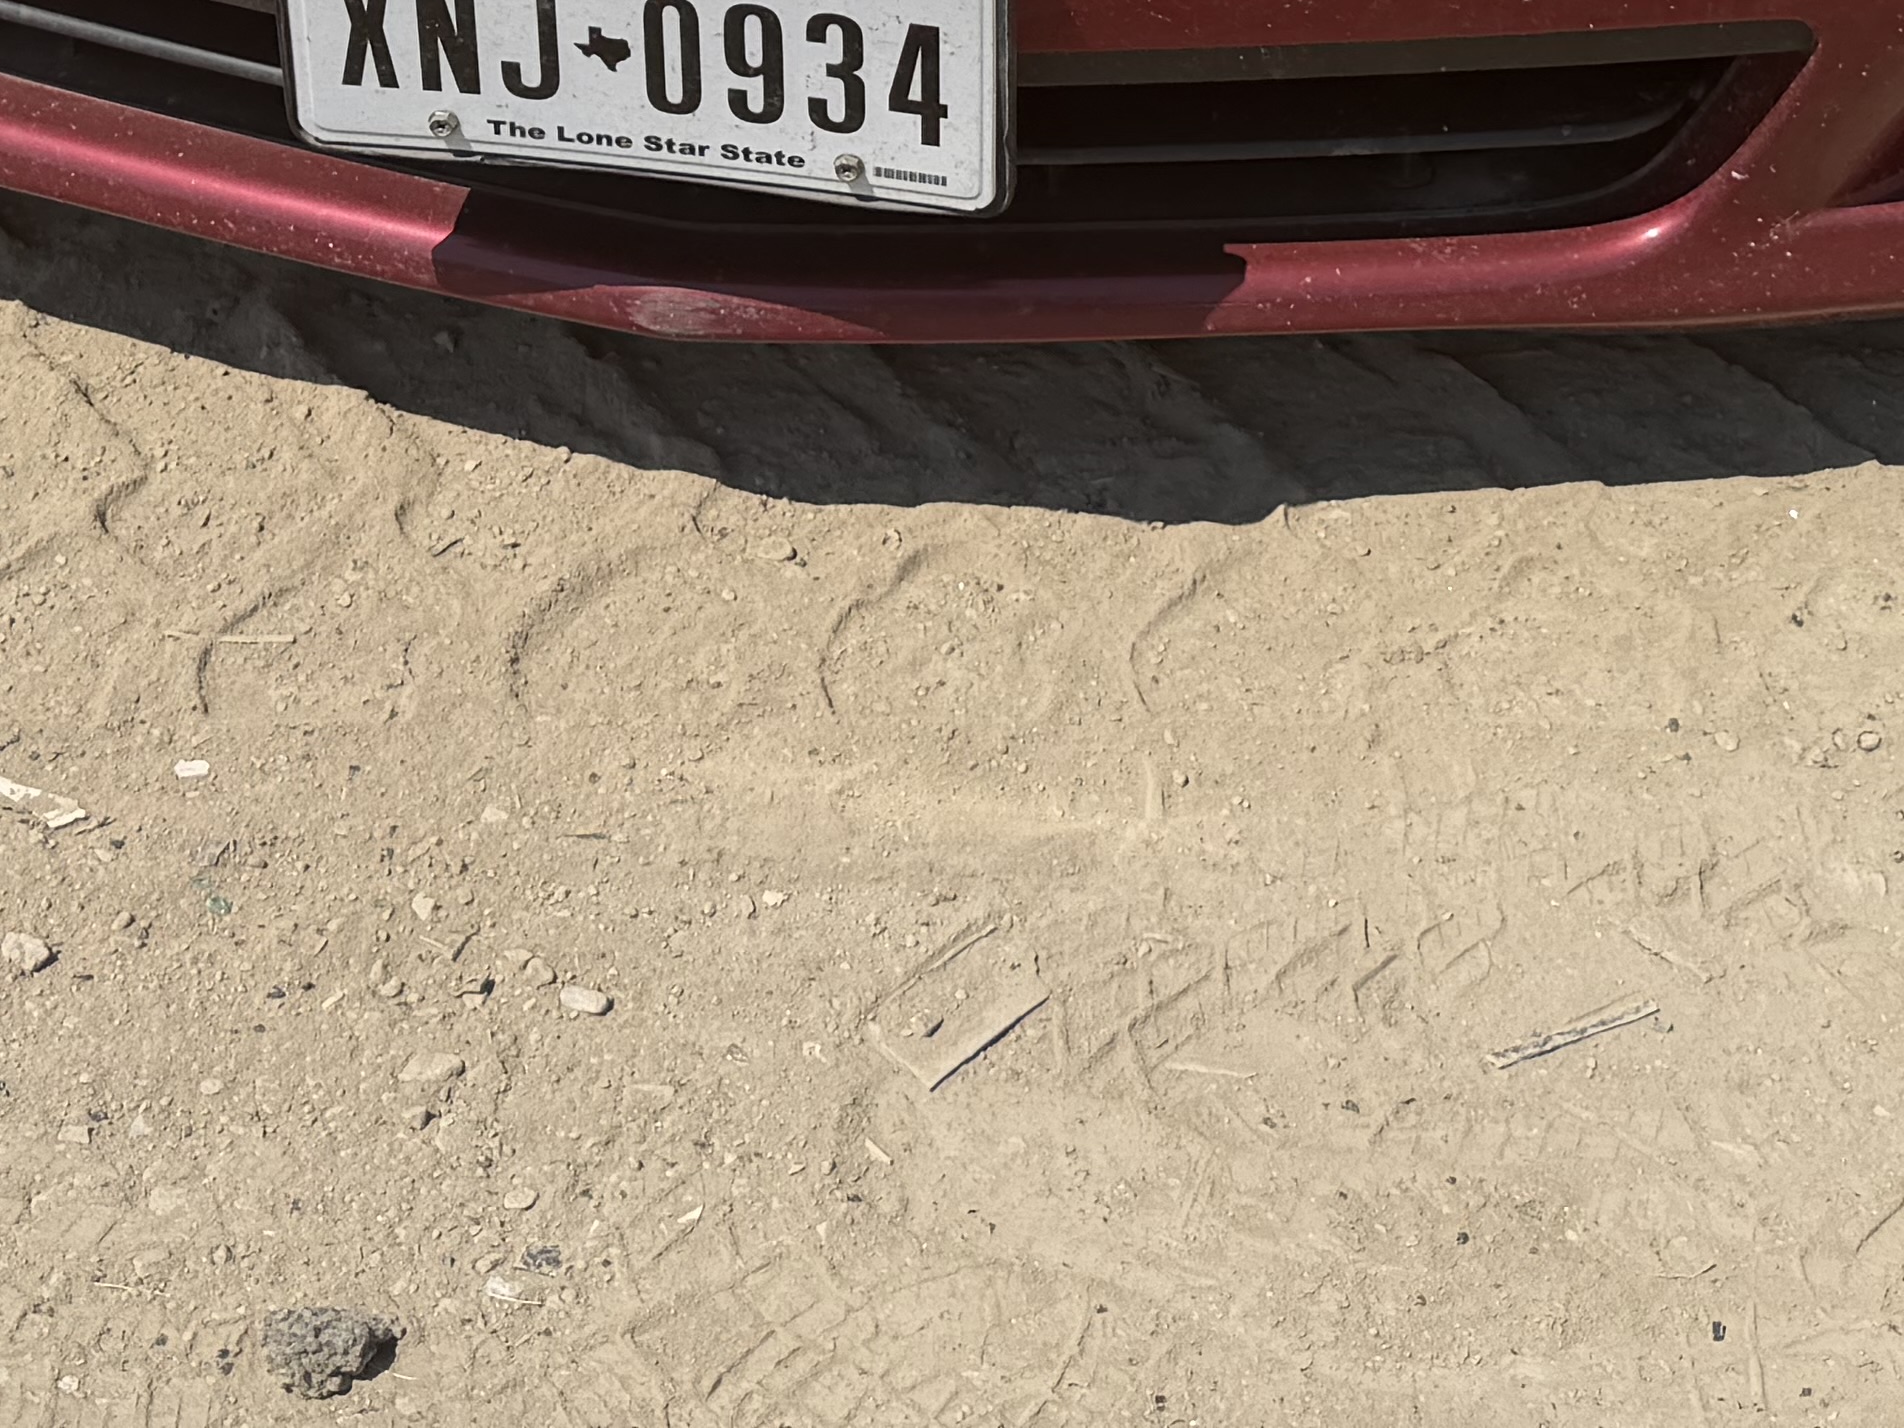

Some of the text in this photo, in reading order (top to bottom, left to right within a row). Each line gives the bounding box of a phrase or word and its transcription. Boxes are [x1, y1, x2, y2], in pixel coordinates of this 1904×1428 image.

[486, 118, 806, 170] The Lone Star State
